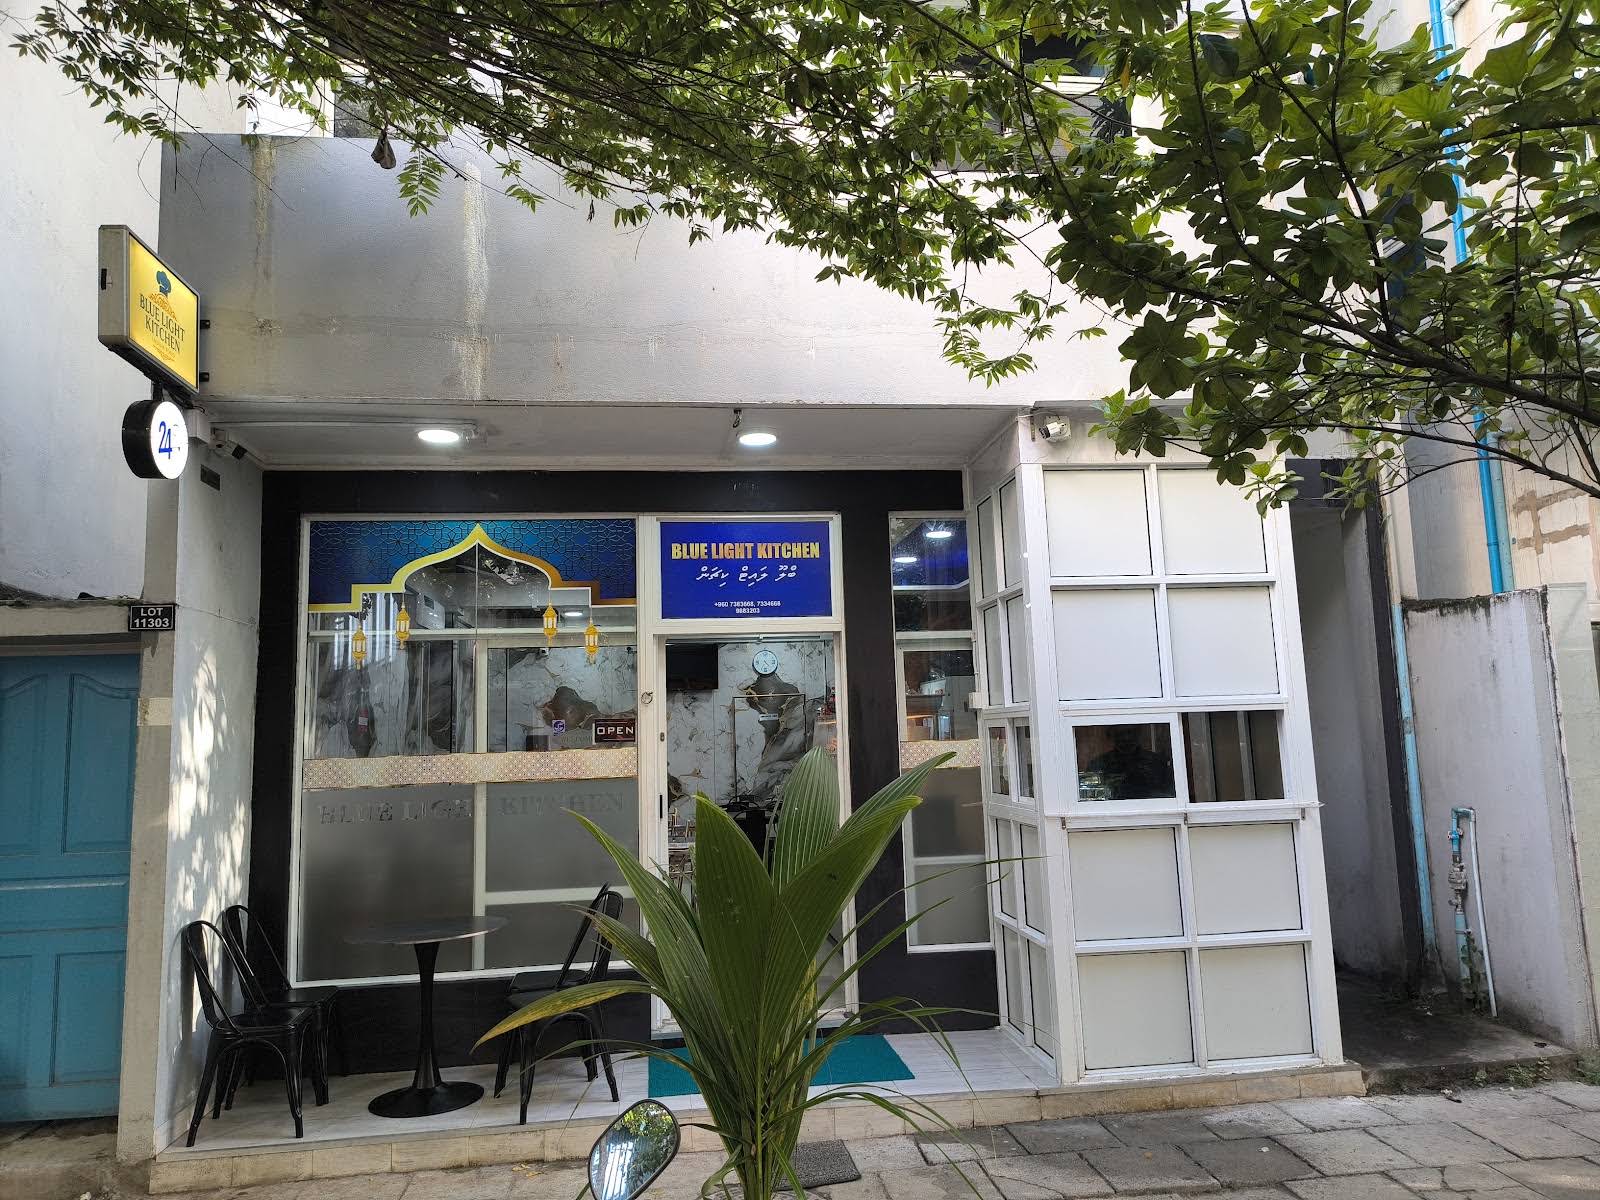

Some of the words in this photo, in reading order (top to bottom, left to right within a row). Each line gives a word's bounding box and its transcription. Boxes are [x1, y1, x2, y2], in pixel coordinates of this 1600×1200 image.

[139, 293, 160, 322] BLUE
[161, 311, 185, 342] LIGHT
[145, 314, 181, 354] KITCHEN
[158, 420, 173, 460] 24
[671, 542, 708, 560] BLUE
[711, 542, 754, 560] LIGHT
[757, 541, 820, 559] KITCHEN
[140, 607, 164, 617] LOT
[134, 618, 170, 628] 11303
[596, 726, 634, 735] OPEN
